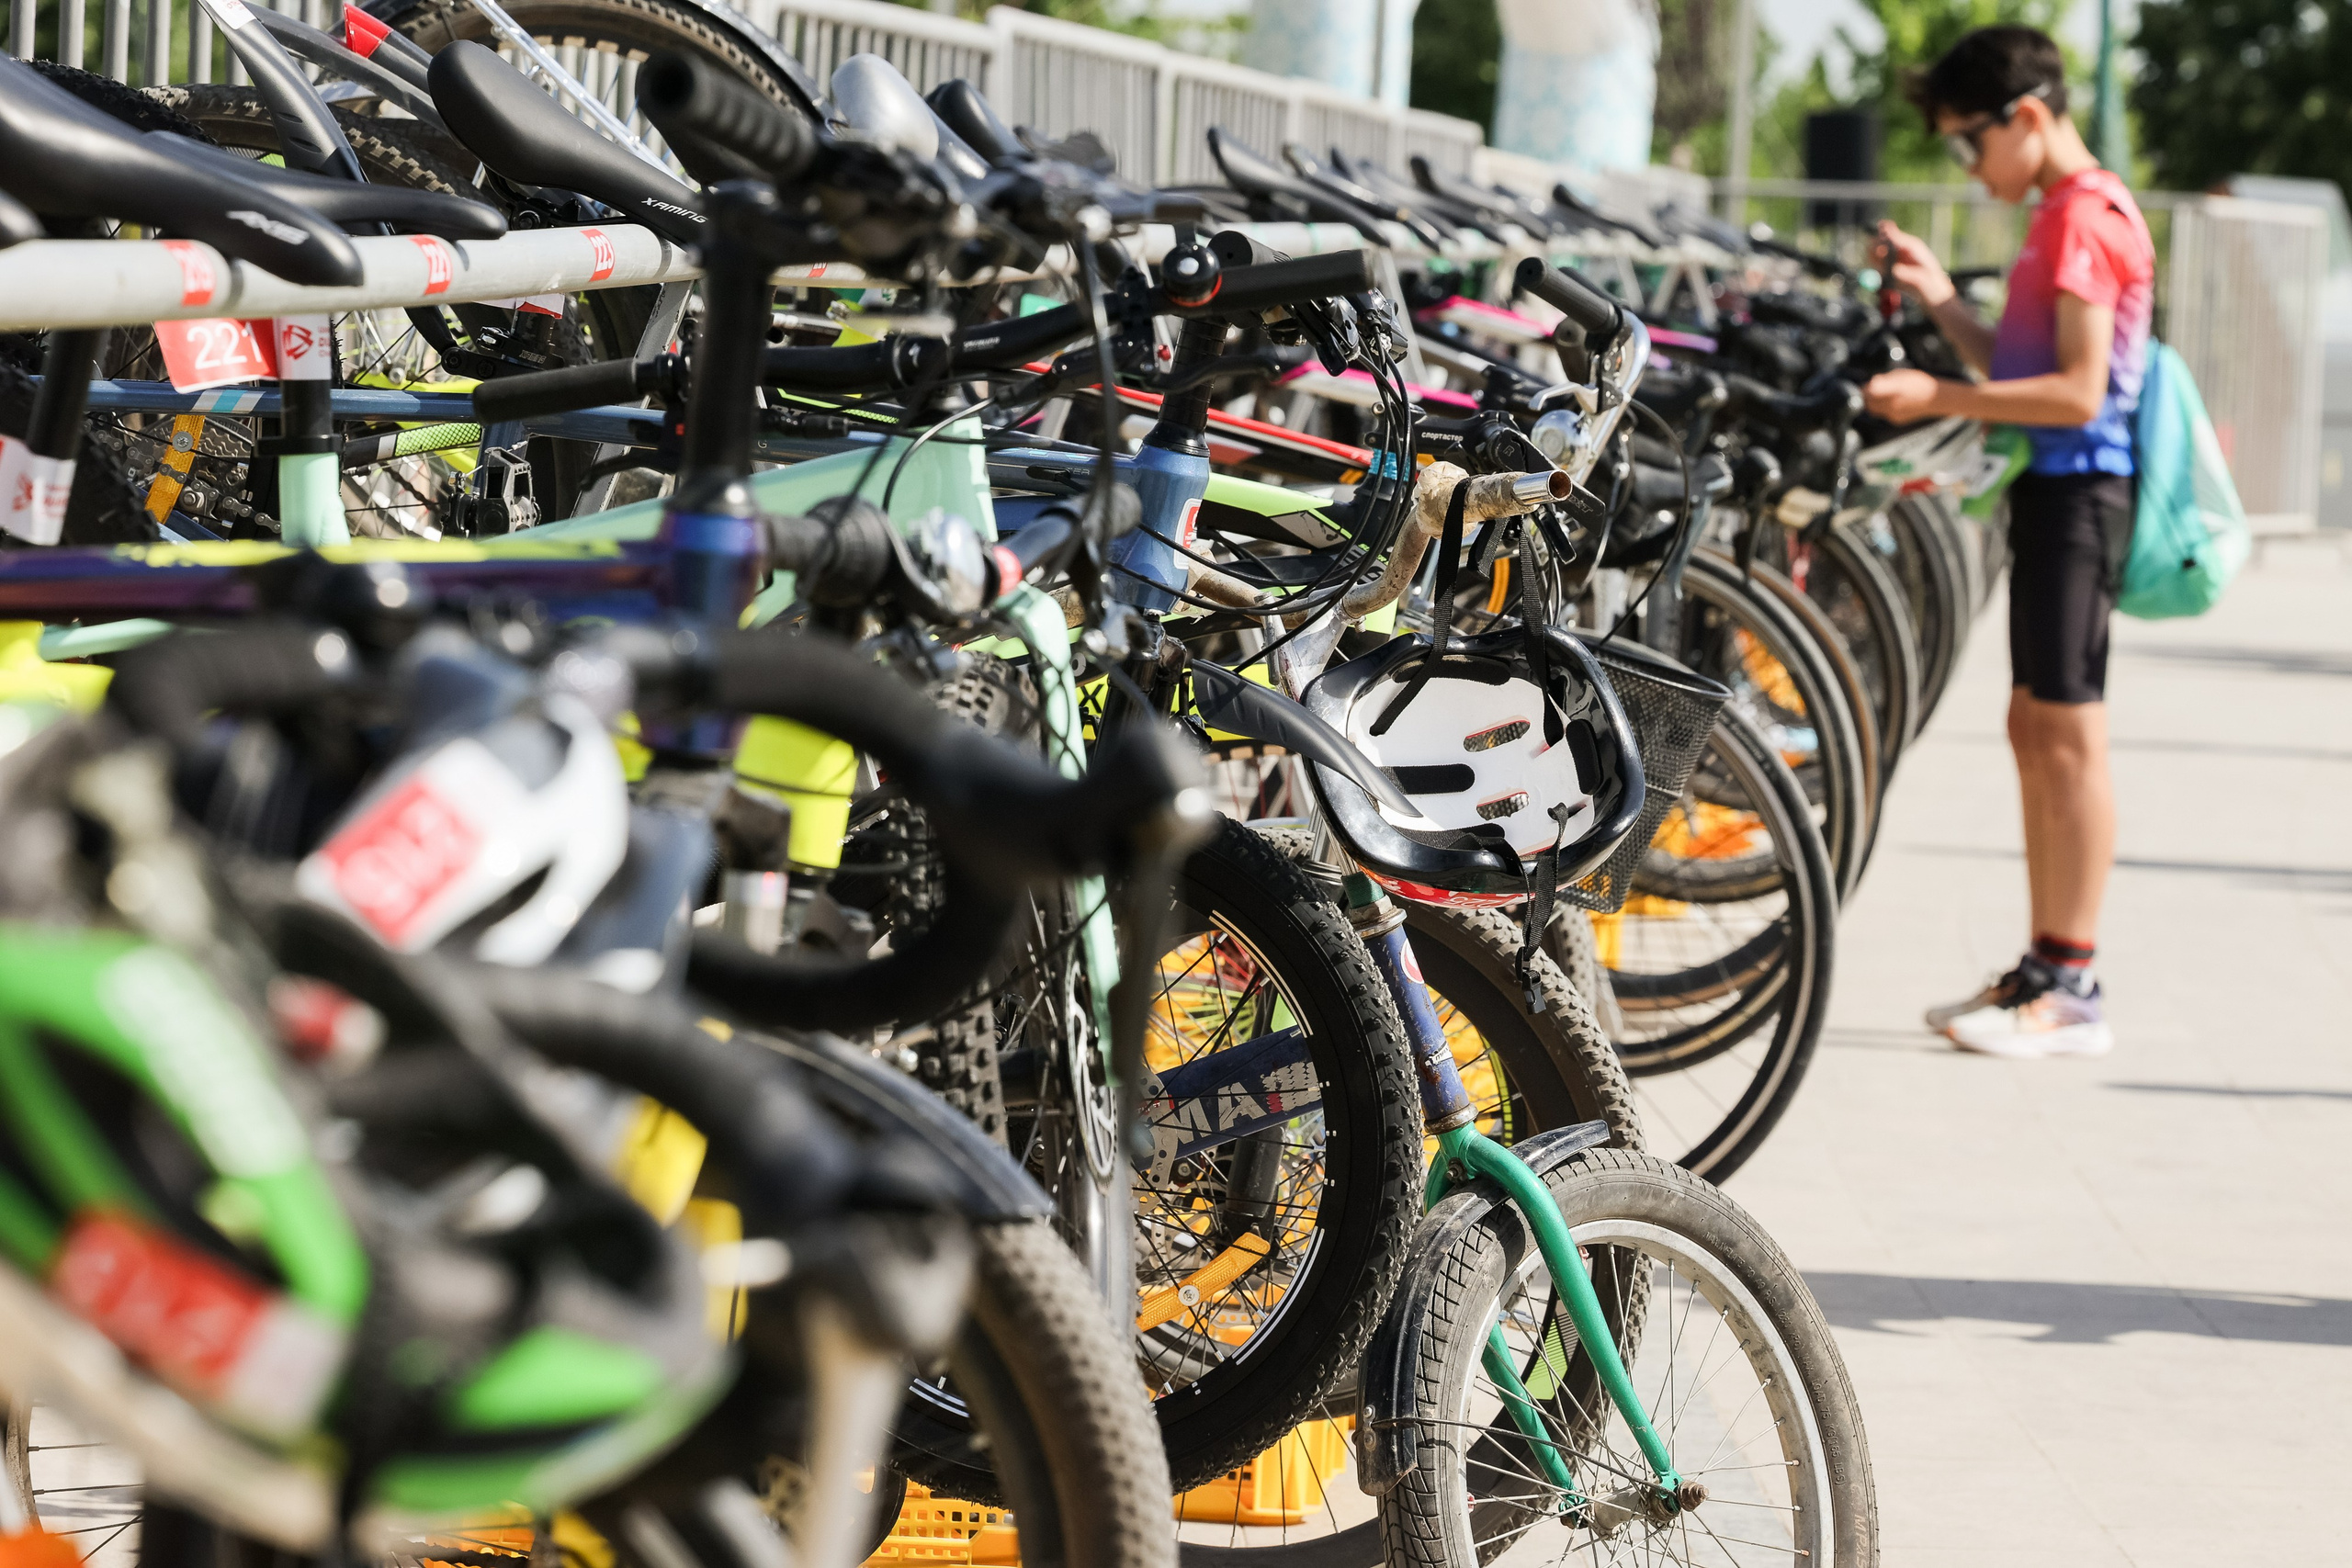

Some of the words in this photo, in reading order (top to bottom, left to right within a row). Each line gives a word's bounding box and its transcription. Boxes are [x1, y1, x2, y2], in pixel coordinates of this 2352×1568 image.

[641, 197, 708, 223] XAMING
[591, 234, 615, 273] 223
[187, 321, 263, 370] 221
[1811, 1380, 1826, 1404] LOAD
